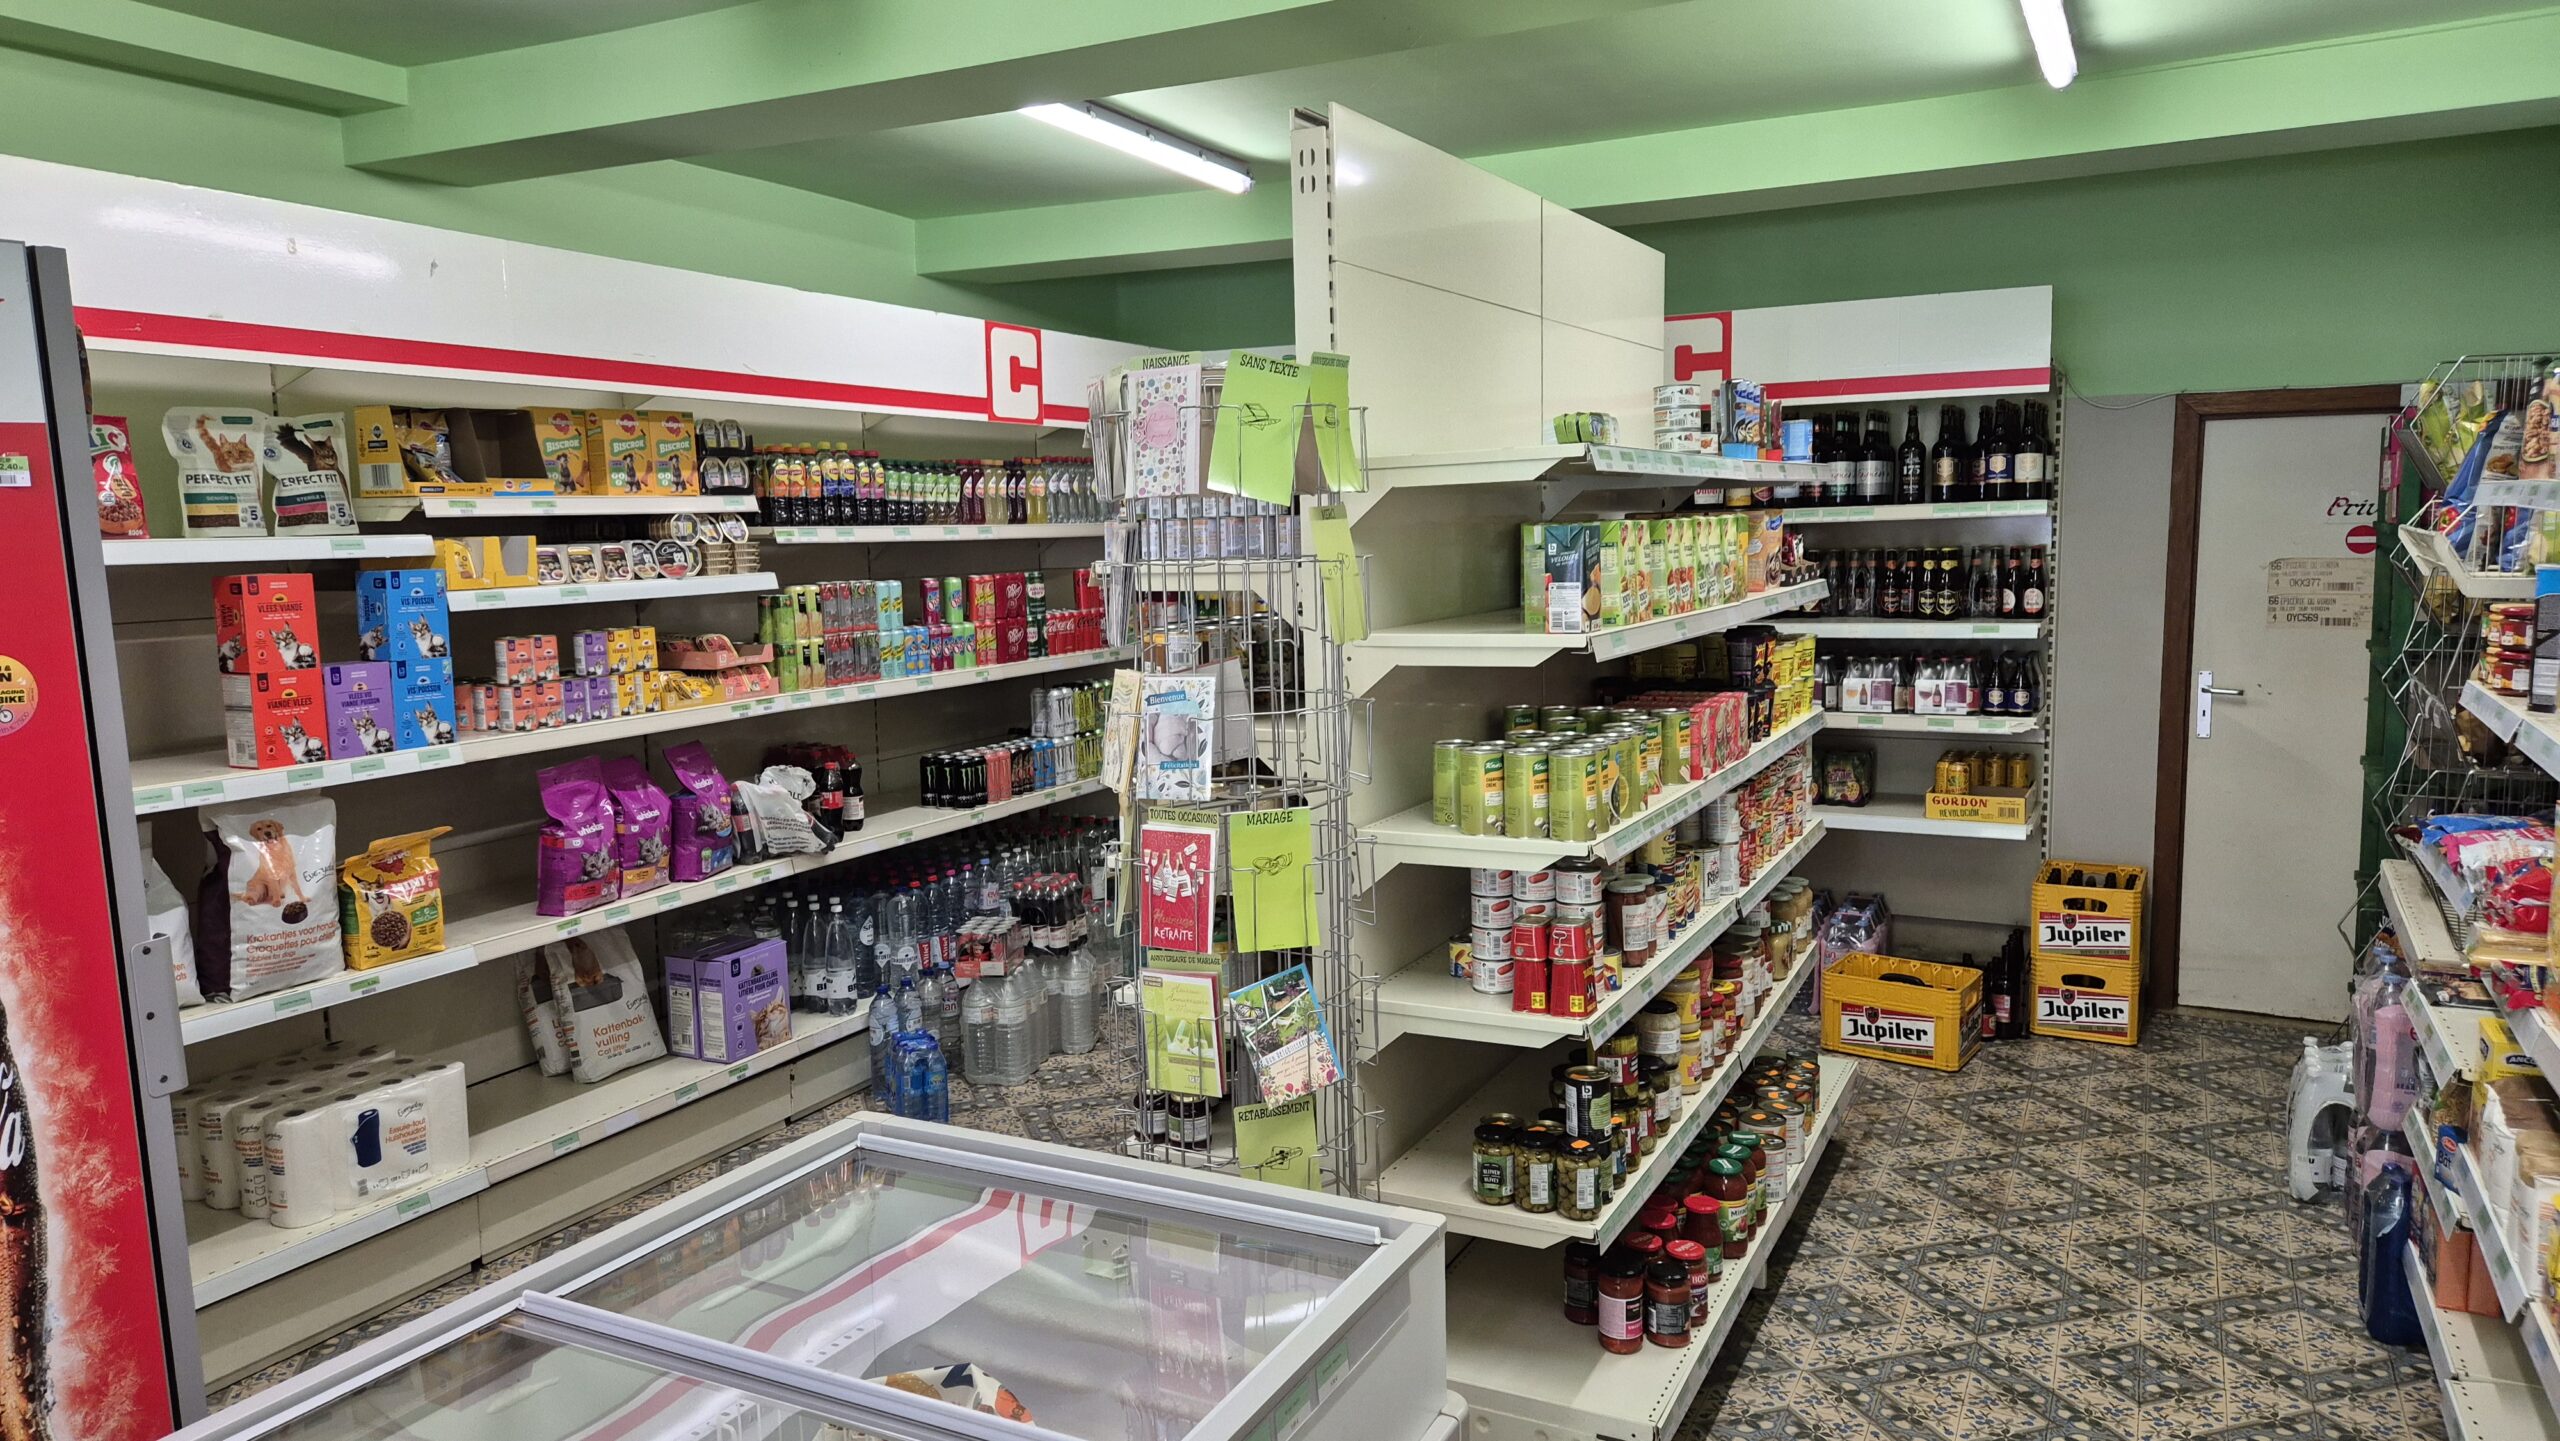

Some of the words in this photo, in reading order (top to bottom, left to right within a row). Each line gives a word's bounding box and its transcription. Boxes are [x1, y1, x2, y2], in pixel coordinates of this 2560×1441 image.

[1142, 355, 1190, 370] NAISSANCE
[1240, 354, 1266, 371] SANS
[1269, 361, 1300, 378] TEXTE
[185, 474, 232, 486] PERFECT
[235, 474, 252, 485] FIT
[281, 474, 323, 488] ERFECT
[325, 473, 338, 484] FIT
[250, 509, 258, 521] 5
[338, 508, 346, 518] 5
[1150, 693, 1185, 704] Bienvenue
[1932, 795, 1988, 808] GORDON
[1150, 808, 1176, 821] TOUTES
[1178, 811, 1218, 825] OCCASIONS
[1246, 811, 1293, 826] MARIAGE
[247, 930, 297, 944] Krokantjes
[1154, 927, 1193, 941] RETRAITE
[2044, 925, 2126, 946] Jupiler
[1151, 954, 1187, 964] ANNIVERSAIRE
[1188, 956, 1196, 964] DE
[1197, 956, 1221, 966] MARIAGE
[2043, 1000, 2125, 1021] Jupiler
[593, 1014, 646, 1038] Kattenbak-
[1847, 1018, 1928, 1042] Jupiler
[595, 1031, 630, 1048] vulling
[597, 1047, 612, 1057] Cat
